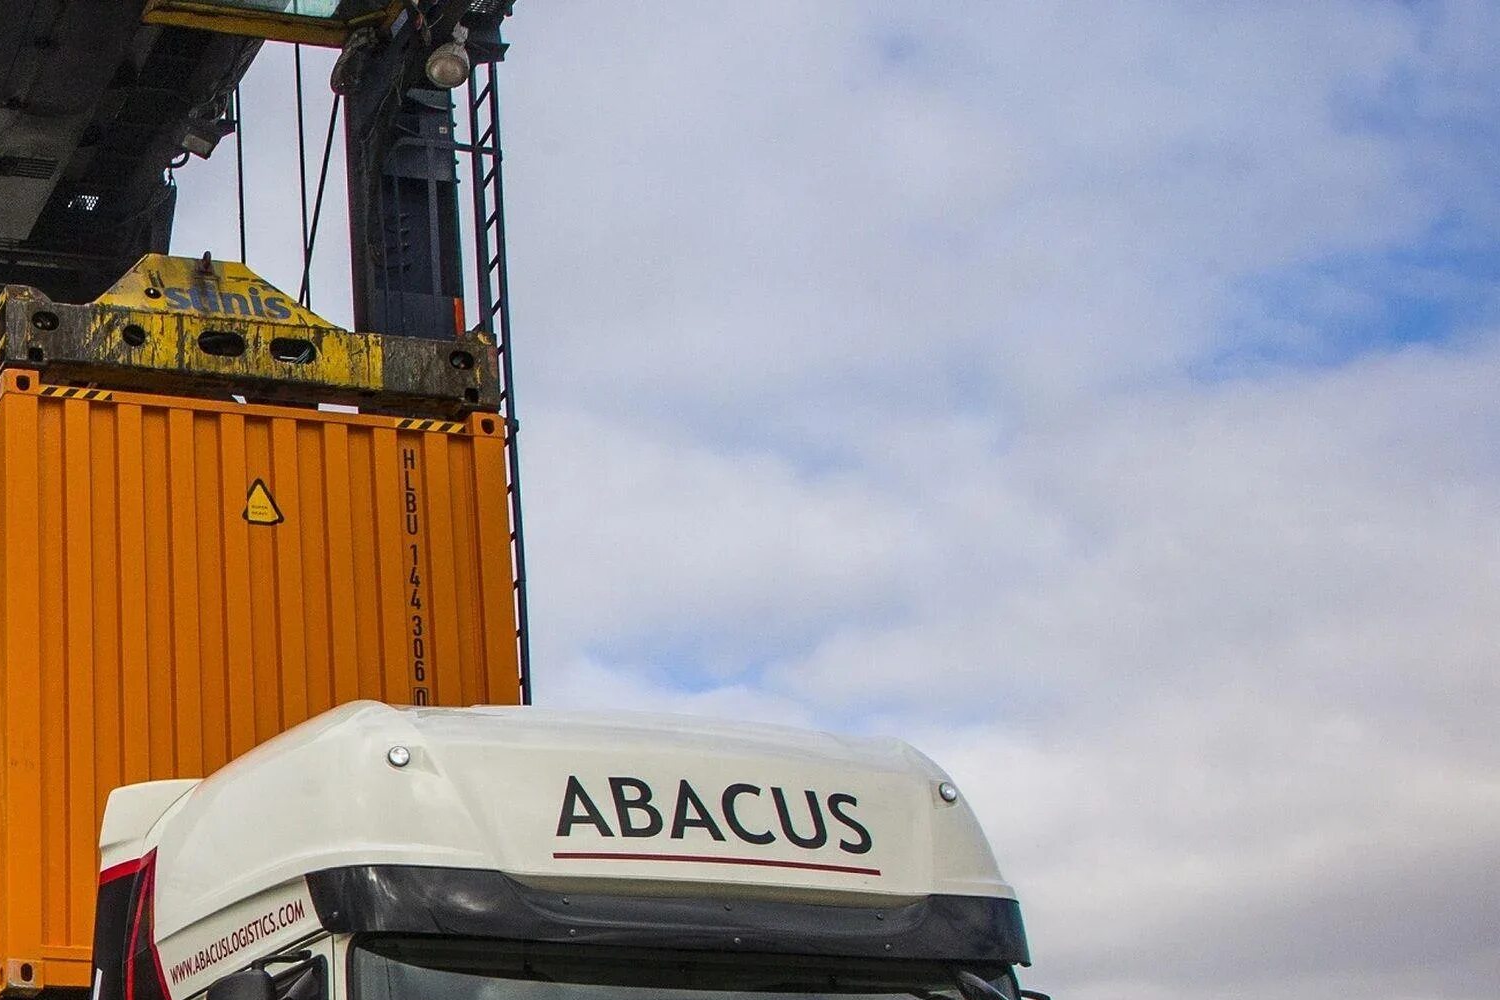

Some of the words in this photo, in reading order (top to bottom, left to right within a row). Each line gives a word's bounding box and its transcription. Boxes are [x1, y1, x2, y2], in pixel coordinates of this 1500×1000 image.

[403, 448, 418, 536] HLBU
[556, 775, 873, 855] ABACUS
[169, 898, 306, 986] WWW.ABACUSLOGISTICS.COM
